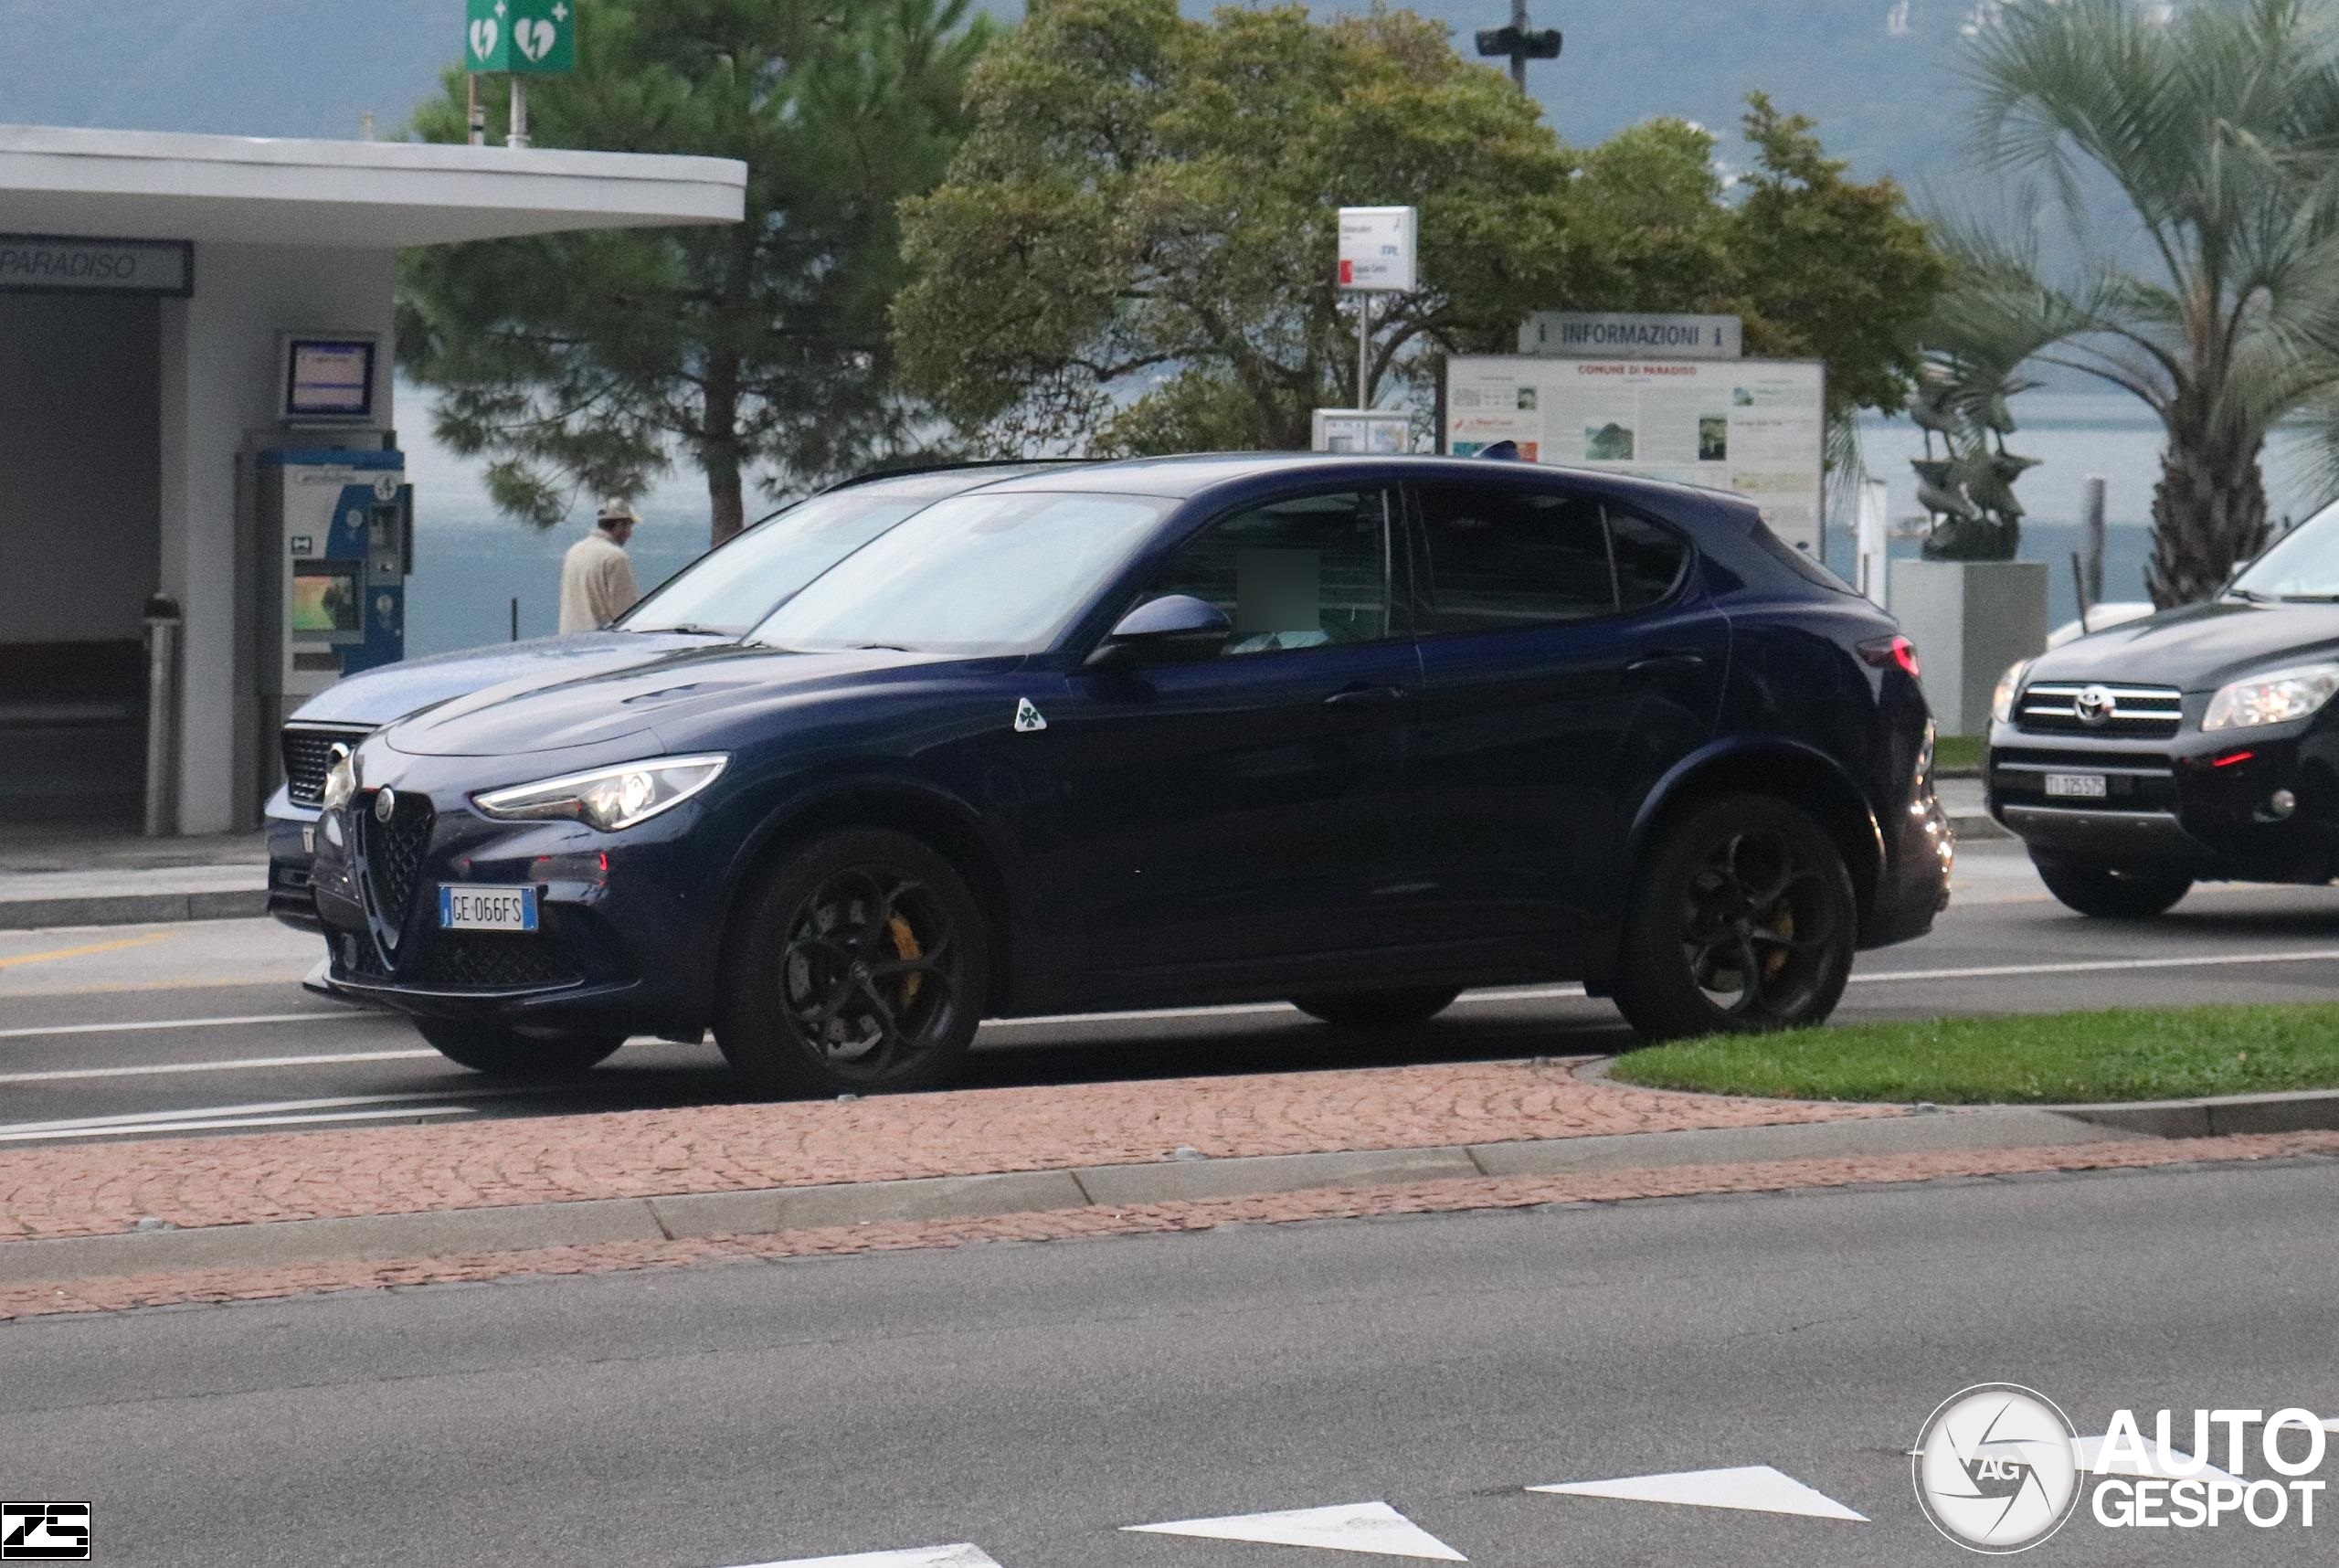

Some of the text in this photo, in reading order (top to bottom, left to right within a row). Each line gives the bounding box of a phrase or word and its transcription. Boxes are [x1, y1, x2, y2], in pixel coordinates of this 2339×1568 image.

[0, 249, 135, 279] PARADISO
[1561, 323, 1699, 345] INFORMAZIONI
[1578, 365, 1698, 376] COMUNE DI PARADISO
[452, 895, 522, 922] GE 066FS
